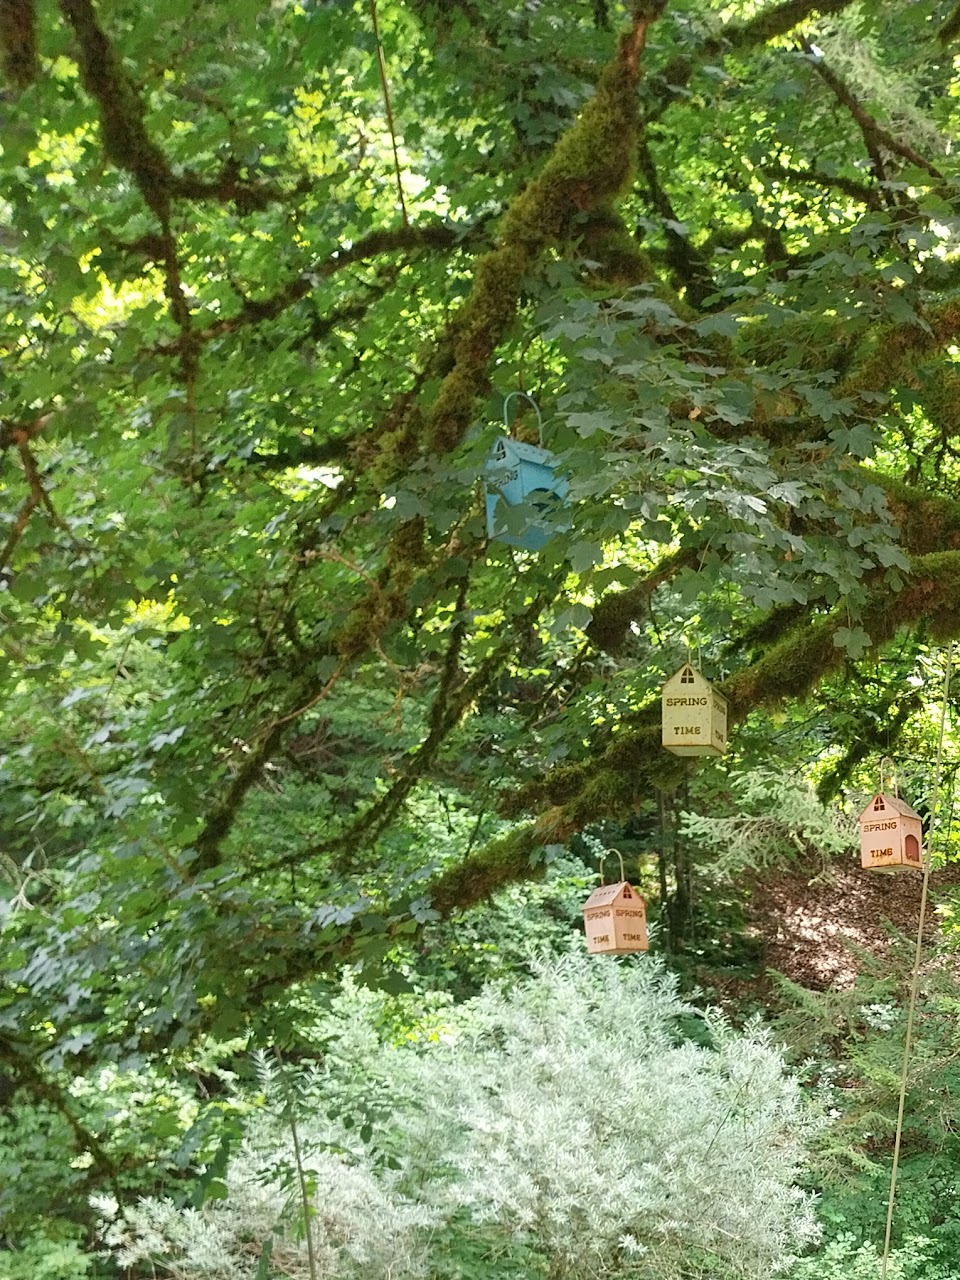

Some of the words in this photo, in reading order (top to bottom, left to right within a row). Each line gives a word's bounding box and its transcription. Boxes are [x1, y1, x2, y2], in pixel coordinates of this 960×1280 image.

[666, 697, 707, 707] SPRING
[673, 726, 701, 735] TIME
[863, 821, 897, 833] SPRING
[870, 848, 893, 858] TIME
[615, 909, 643, 918] SPRING
[592, 934, 609, 944] TIME
[622, 933, 641, 941] TIME
